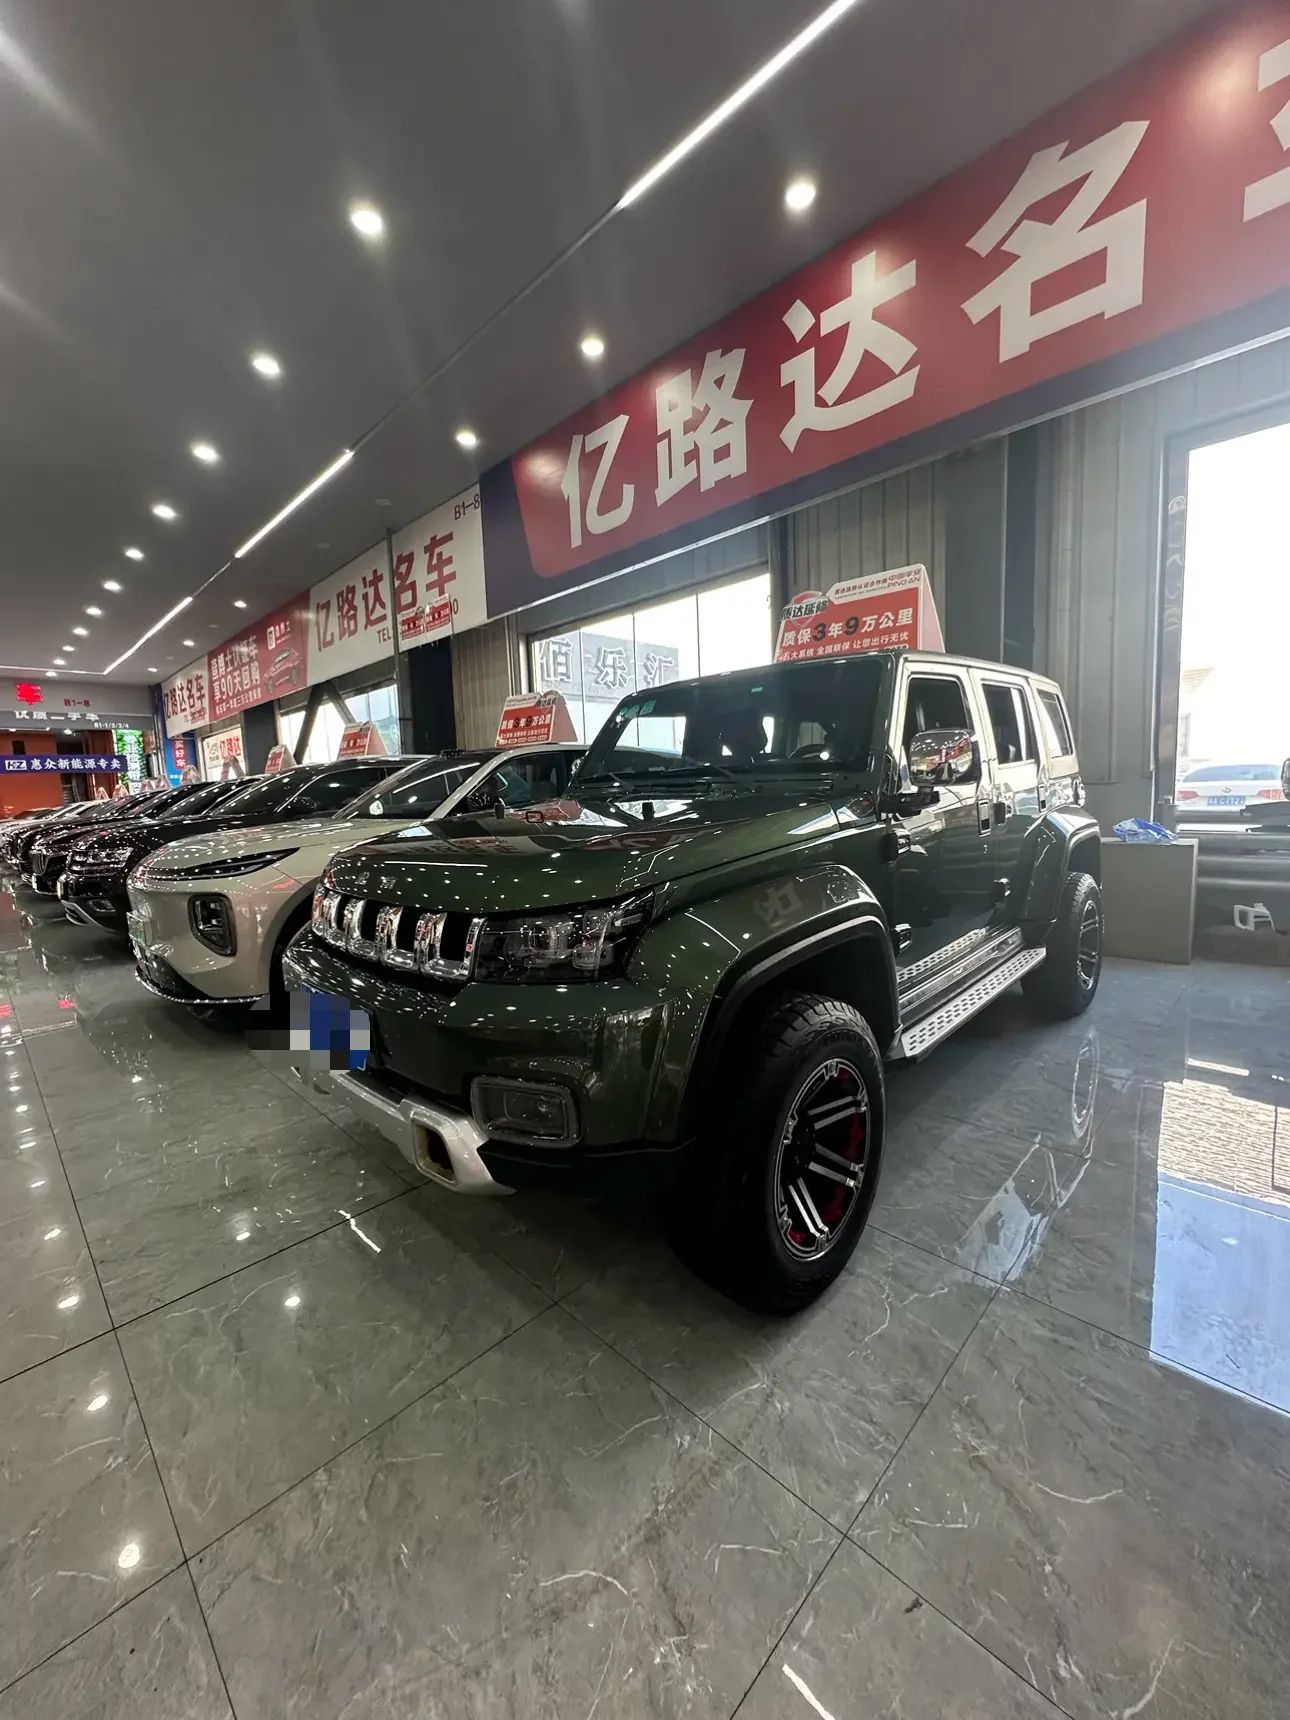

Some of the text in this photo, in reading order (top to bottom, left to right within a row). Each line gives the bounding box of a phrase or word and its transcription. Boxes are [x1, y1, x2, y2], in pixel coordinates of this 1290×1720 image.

[316, 532, 457, 652] 亿路达名车
[782, 607, 913, 647] 质保3年9万公里
[817, 641, 850, 655] 全国联保
[853, 631, 909, 648] 让您出行无忧
[31, 758, 121, 770] 惠众新能源专卖
